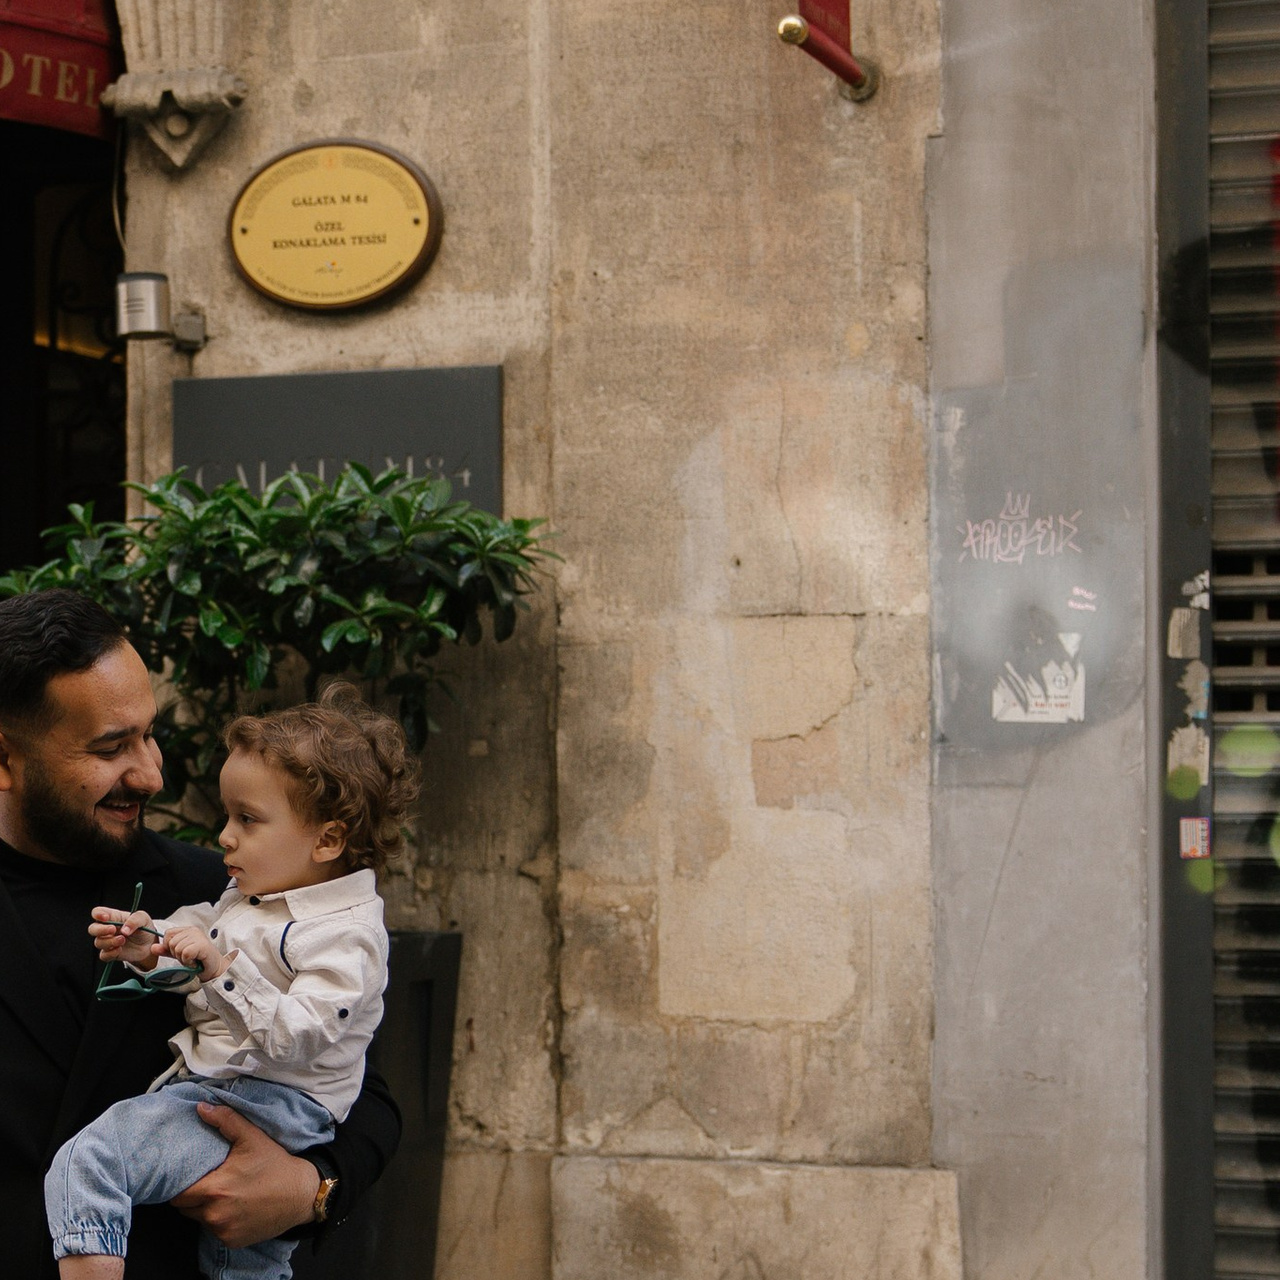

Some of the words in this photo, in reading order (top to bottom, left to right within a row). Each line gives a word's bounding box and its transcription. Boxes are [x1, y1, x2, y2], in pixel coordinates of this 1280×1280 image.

[291, 194, 337, 208] GALATA
[313, 220, 345, 233] ÖZEL
[272, 236, 346, 250] KONAKLAMA
